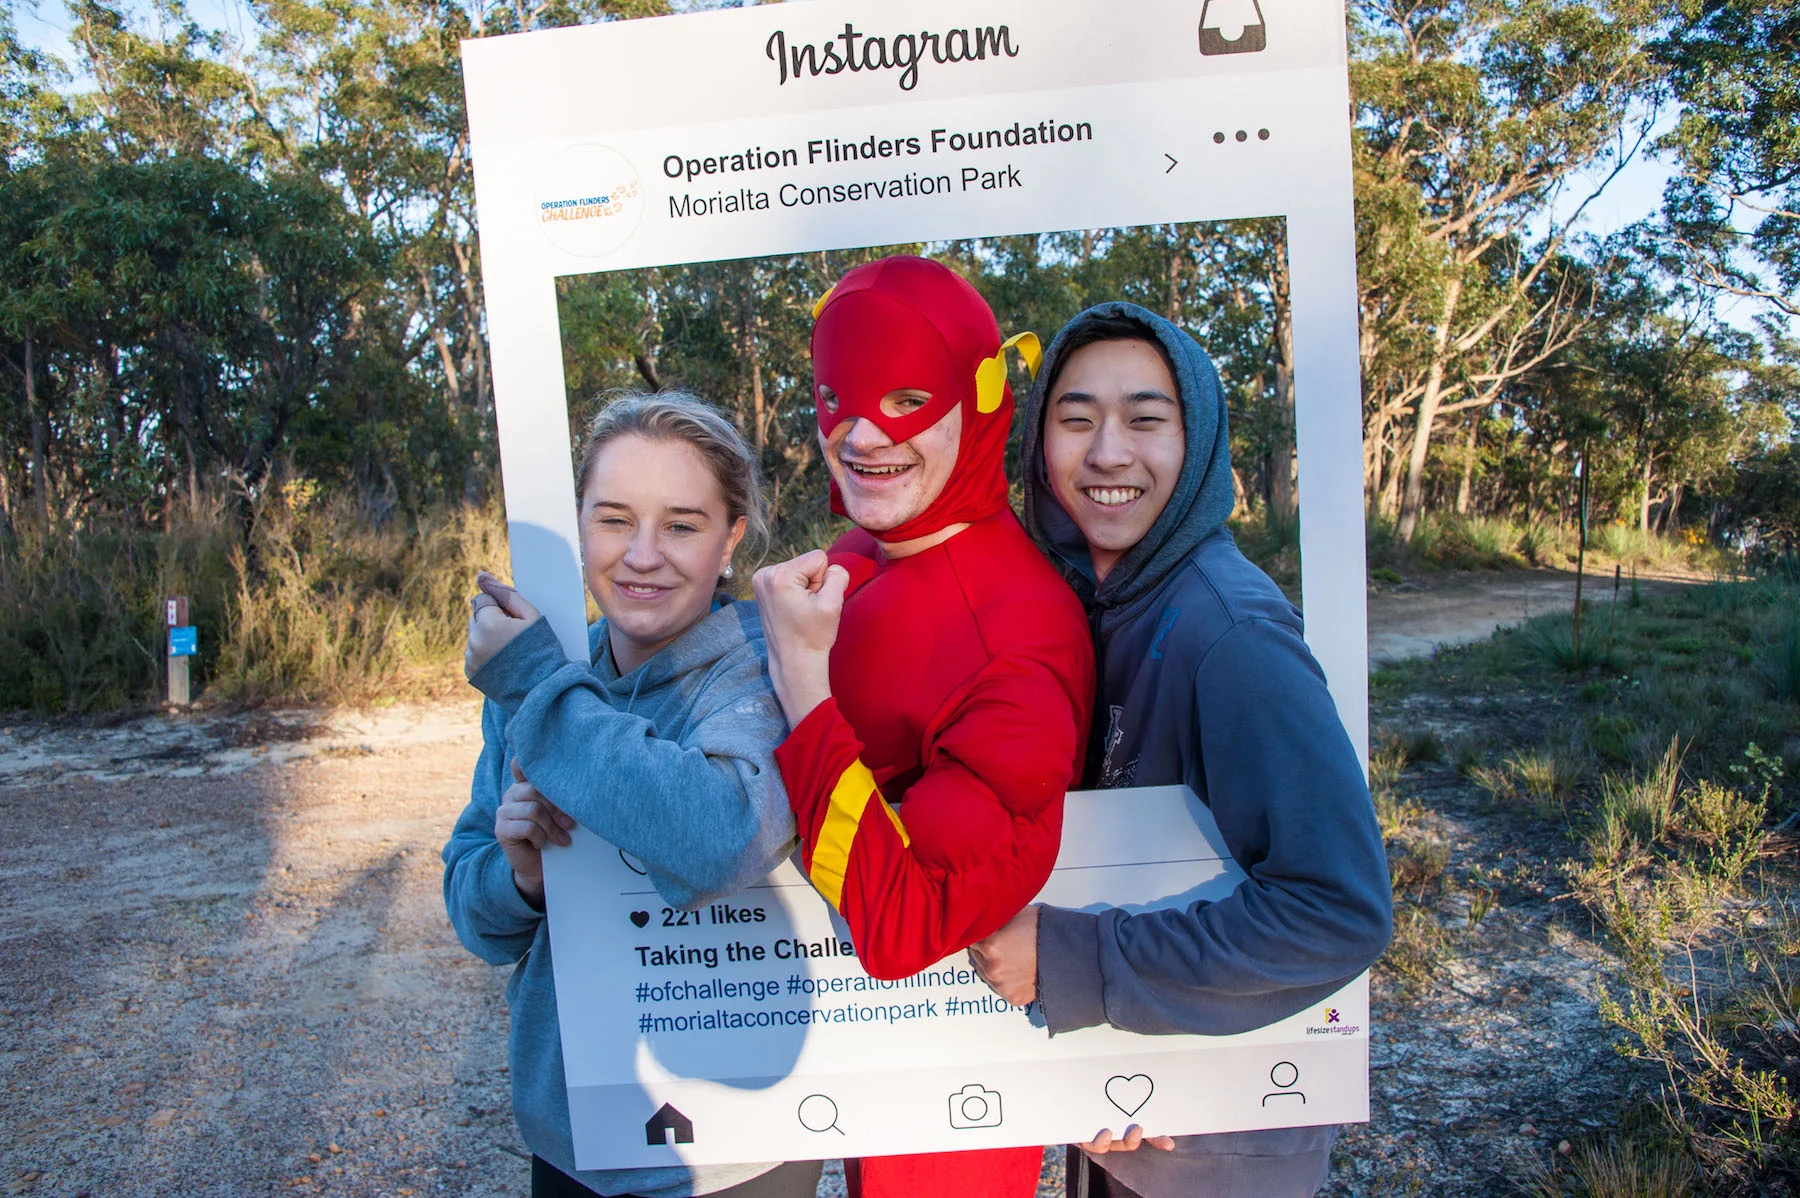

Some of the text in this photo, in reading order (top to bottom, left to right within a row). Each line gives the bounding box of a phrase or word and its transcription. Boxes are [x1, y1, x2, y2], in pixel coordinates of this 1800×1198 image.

[766, 23, 1019, 91] Instagram
[662, 119, 1093, 182] Operation Flinders Foundation
[541, 196, 609, 210] OPERATION FLINDERS
[669, 164, 1023, 219] Morialta Conservation Park
[541, 205, 603, 222] CHALLENGE
[710, 904, 767, 925] likes
[634, 937, 853, 969] Taking the Challe
[635, 978, 780, 1003] #ofchallenge
[638, 994, 1034, 1034] #morialtaconcervationpark #mtloy
